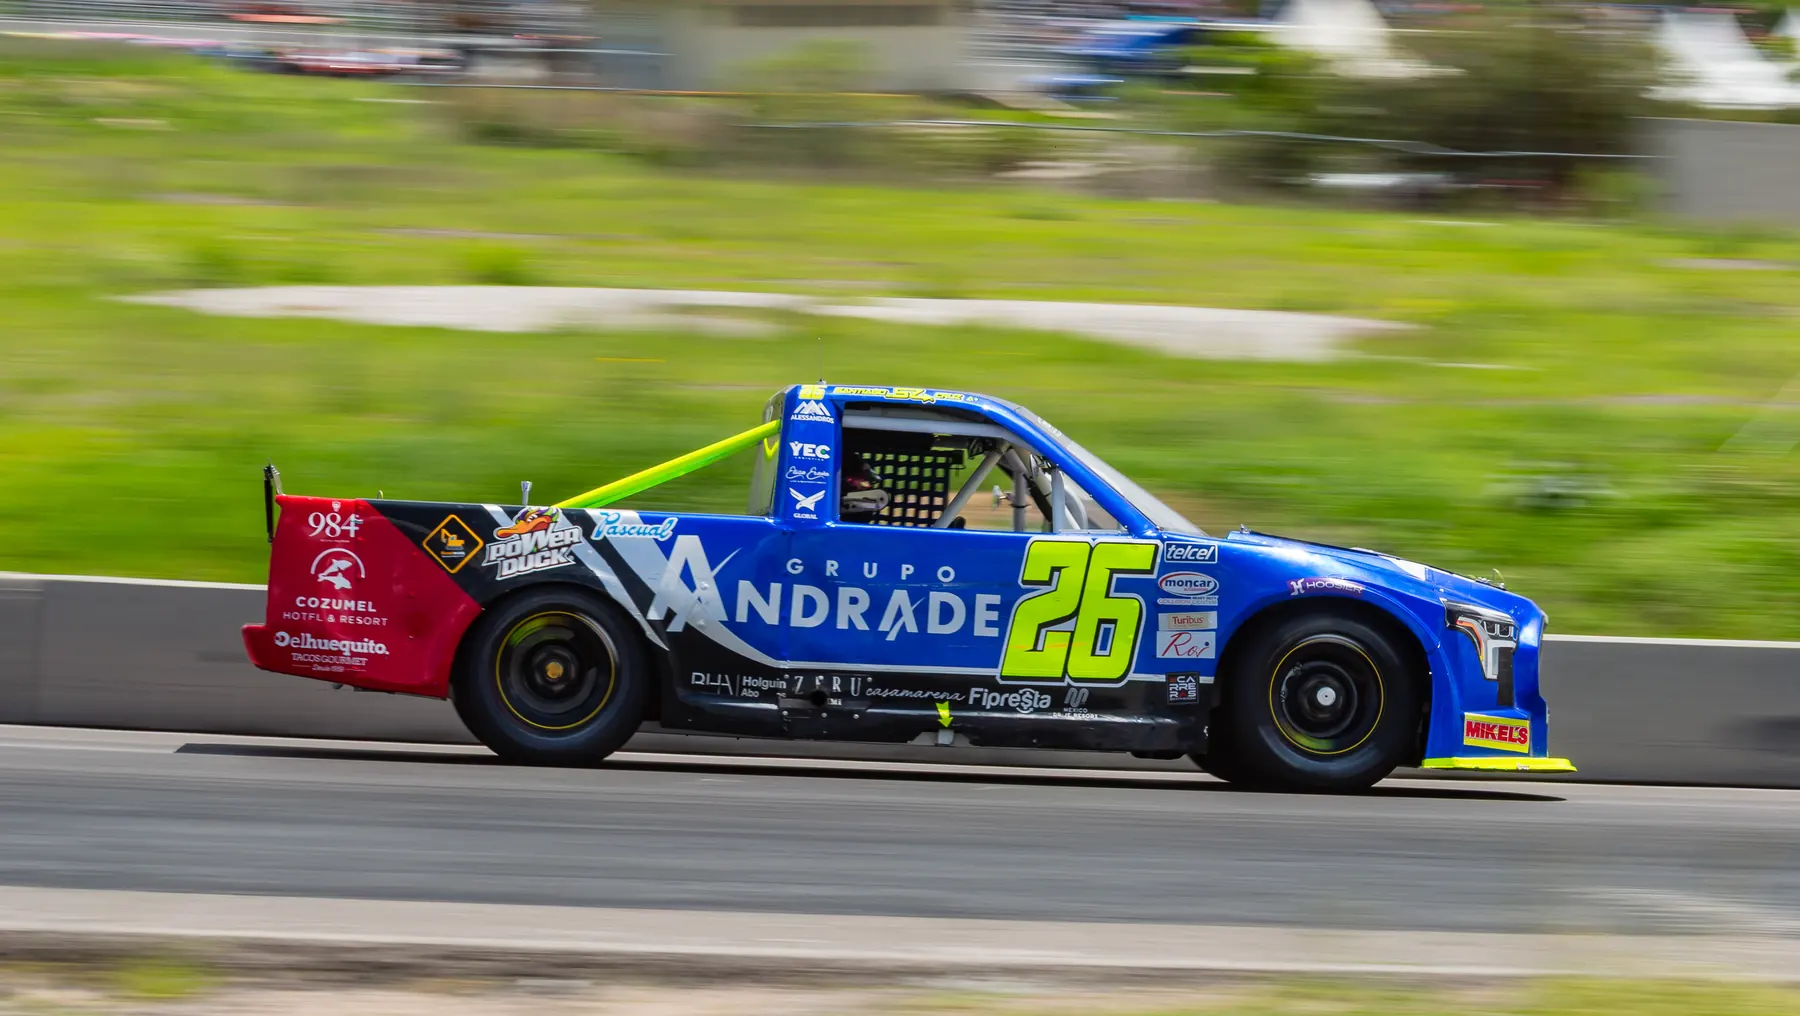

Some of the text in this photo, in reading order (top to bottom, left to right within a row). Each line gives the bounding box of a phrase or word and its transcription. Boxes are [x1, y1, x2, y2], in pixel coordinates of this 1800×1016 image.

[790, 413, 835, 424] ALESSANDROS
[789, 441, 831, 459] YEC
[793, 512, 818, 520] GLOBAL
[594, 512, 673, 539] Pascual
[1166, 544, 1216, 560] telcel
[501, 547, 570, 576] DUCK
[786, 558, 956, 583] GRUPO
[646, 535, 1001, 641] ANDRADE
[1165, 579, 1212, 588] moncar
[1306, 580, 1362, 594] HOOSIER
[295, 596, 377, 613] COZUMEL
[1000, 540, 1157, 682] 26
[327, 614, 336, 623] &
[339, 614, 388, 627] RESORT
[1172, 615, 1204, 625] Turibus
[742, 676, 787, 690] Holguin
[1465, 720, 1529, 745] MIKEL'S
